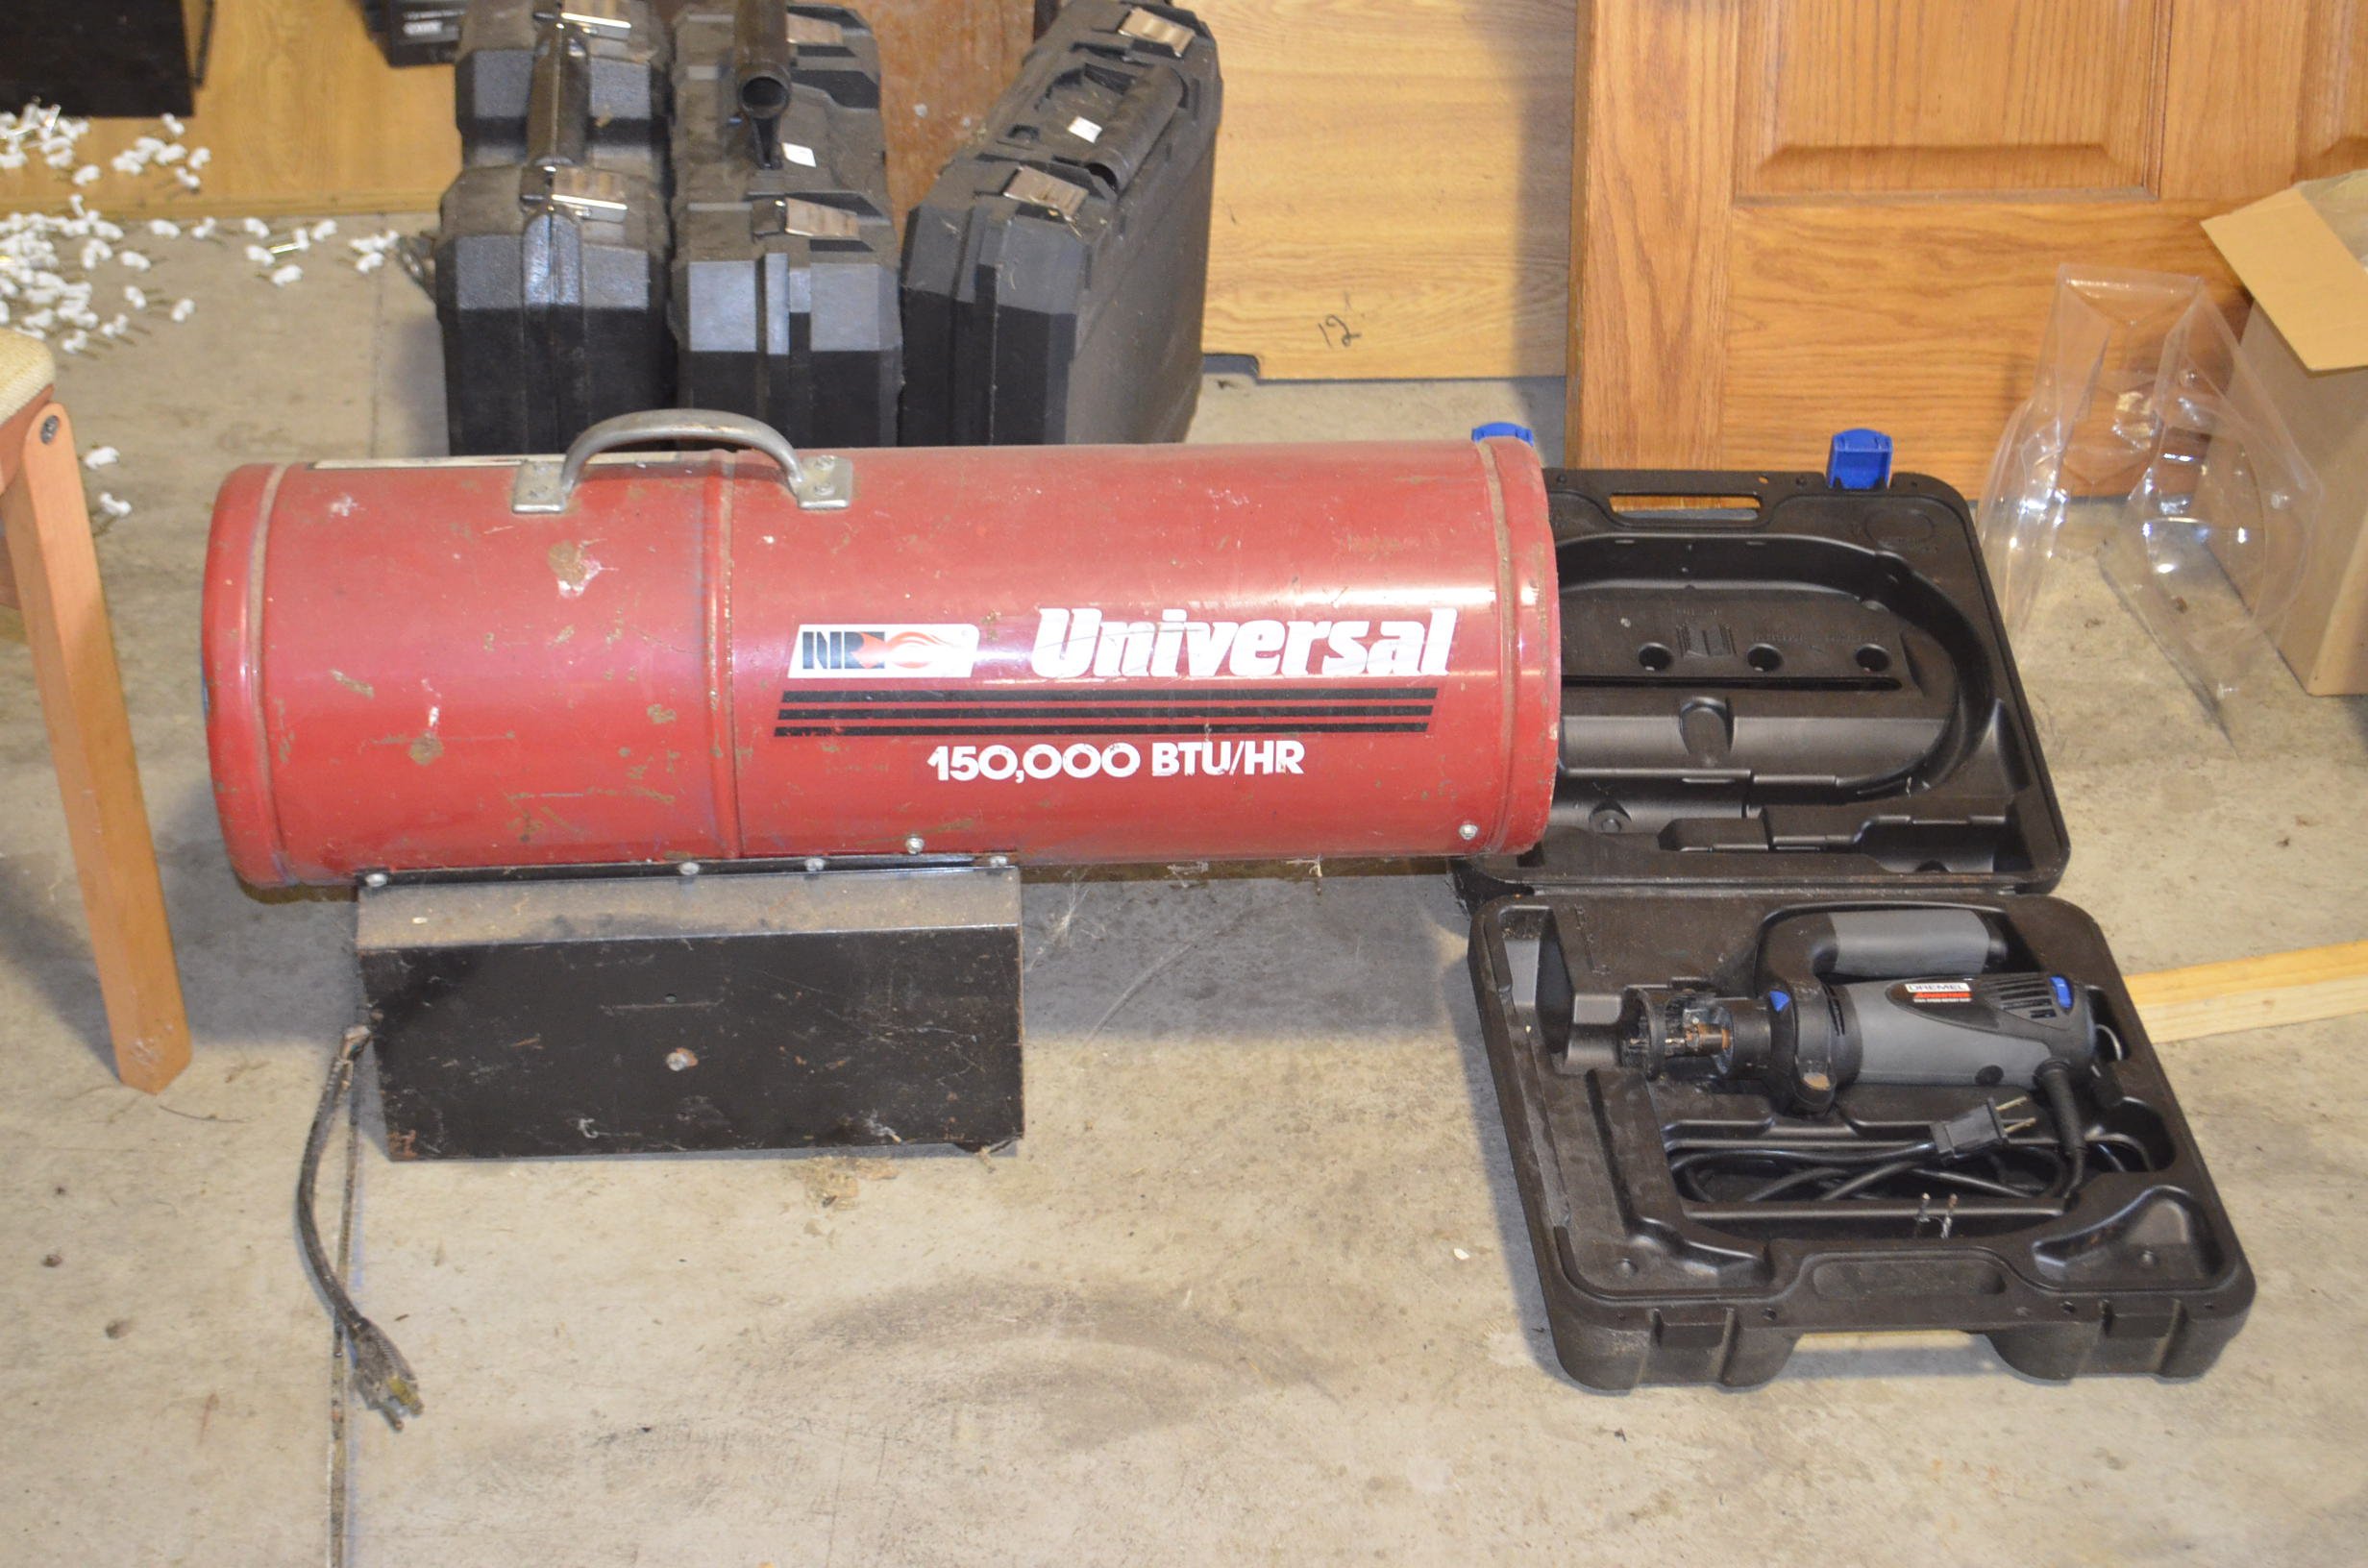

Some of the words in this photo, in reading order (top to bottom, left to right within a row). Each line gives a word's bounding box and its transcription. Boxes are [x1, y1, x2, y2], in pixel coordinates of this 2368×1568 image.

[1318, 314, 1362, 348] 12
[1030, 608, 1458, 677] Universal
[927, 743, 1141, 782] 150,000
[1151, 740, 1305, 776] BTU/HR
[1908, 983, 1965, 992] DREMEL
